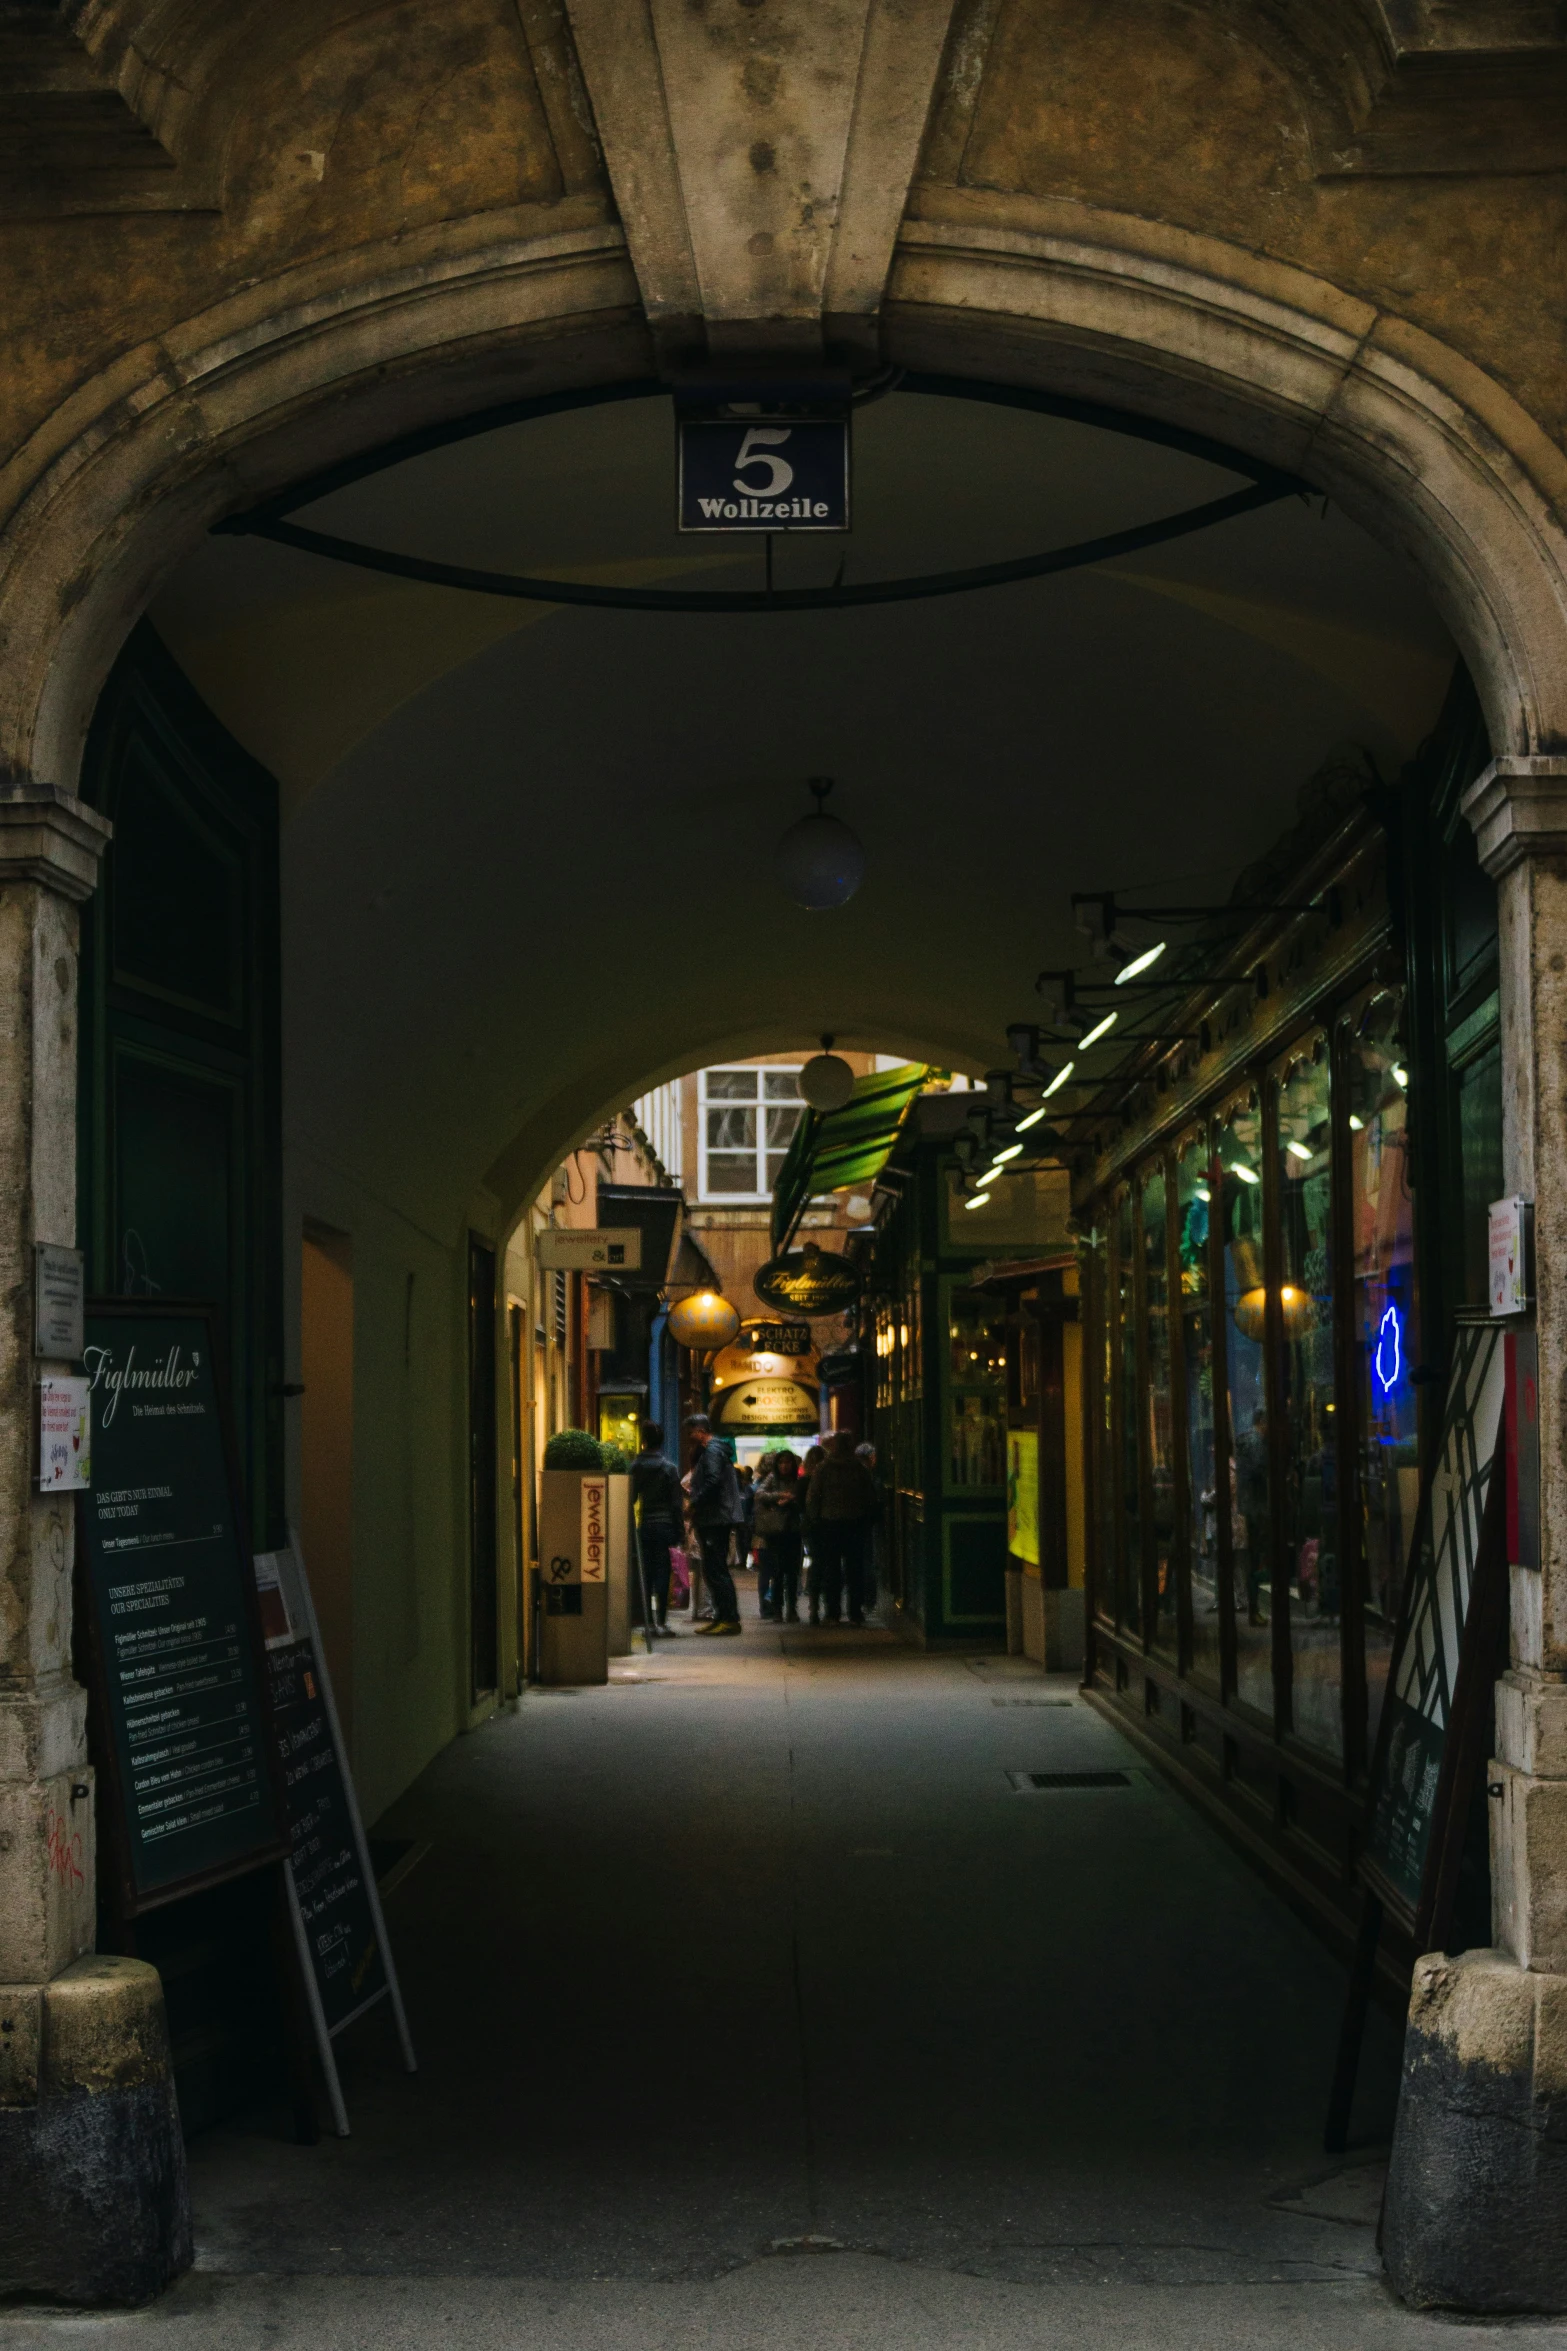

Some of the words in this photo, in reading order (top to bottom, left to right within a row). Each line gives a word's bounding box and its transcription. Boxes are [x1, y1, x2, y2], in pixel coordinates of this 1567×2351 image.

[733, 427, 793, 497] 5
[697, 497, 829, 518] Wollzeile
[554, 1234, 608, 1246] jewellery
[592, 1250, 605, 1262] &
[763, 1271, 856, 1295] Figlmüller
[758, 1328, 808, 1340] SCHATZ
[764, 1342, 801, 1353] ECKE
[83, 1345, 200, 1429] Figlmüller
[132, 1405, 143, 1416] Die
[144, 1404, 165, 1416] Heimat
[165, 1403, 176, 1415] des
[96, 1492, 110, 1504] DAS
[132, 1489, 147, 1500] NUR
[147, 1486, 172, 1498] EINMAL
[98, 1507, 116, 1519] ONLY
[116, 1505, 138, 1517] TODAY
[584, 1484, 604, 1579] jewellery
[102, 1540, 115, 1548] Unser
[551, 1556, 571, 1583] &
[108, 1585, 135, 1599] UNSERE
[136, 1576, 184, 1594] SPEZIALITÄTEN
[111, 1602, 126, 1614] OUR
[126, 1595, 169, 1612] SPECIALITIES
[158, 1627, 170, 1635] Unser
[170, 1623, 186, 1632] Original
[195, 1617, 206, 1627] 1905
[120, 1672, 134, 1680] Wiener
[160, 1709, 180, 1722] gebacken
[135, 1780, 150, 1790] Cordon
[150, 1777, 160, 1785] Bleu
[138, 1800, 163, 1814] Emmentaler
[163, 1794, 183, 1808] gebacken
